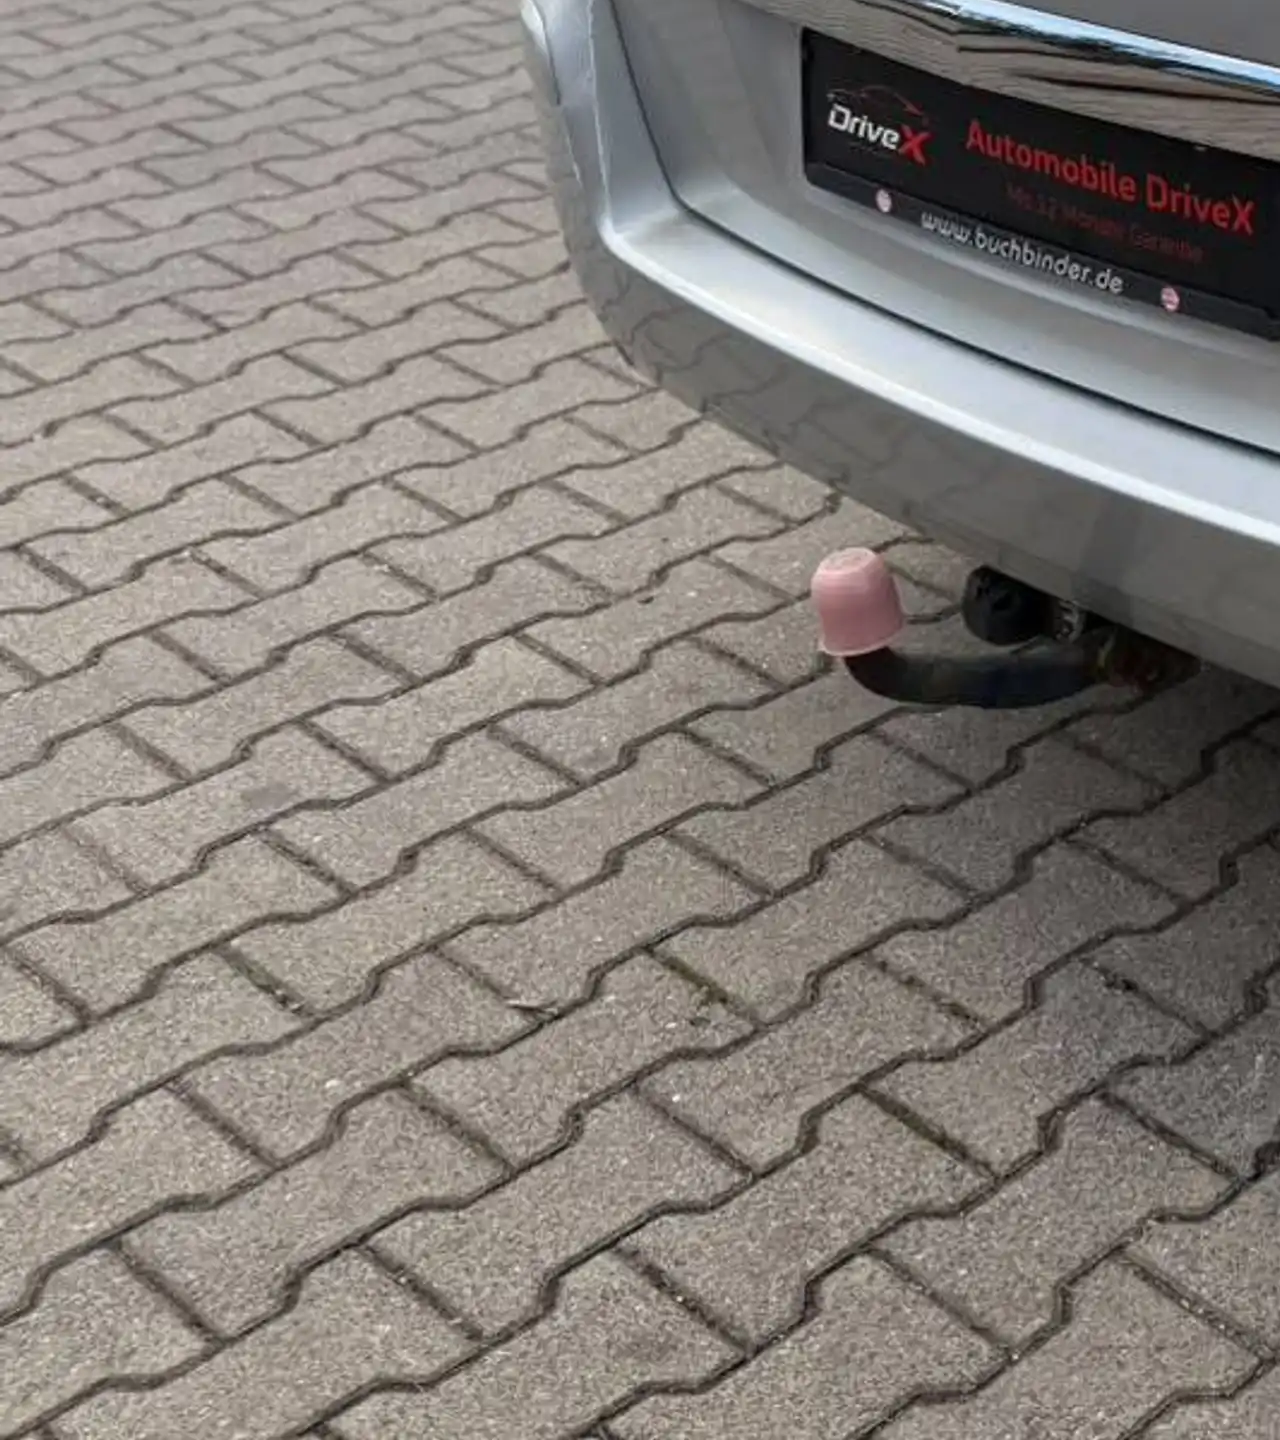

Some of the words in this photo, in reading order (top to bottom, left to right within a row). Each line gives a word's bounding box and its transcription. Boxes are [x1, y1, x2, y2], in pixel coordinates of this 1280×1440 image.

[828, 103, 932, 166] DriveX
[966, 119, 1135, 203] Automobile
[1146, 173, 1255, 235] DriveX
[921, 211, 1124, 294] www.buchbinder.de
